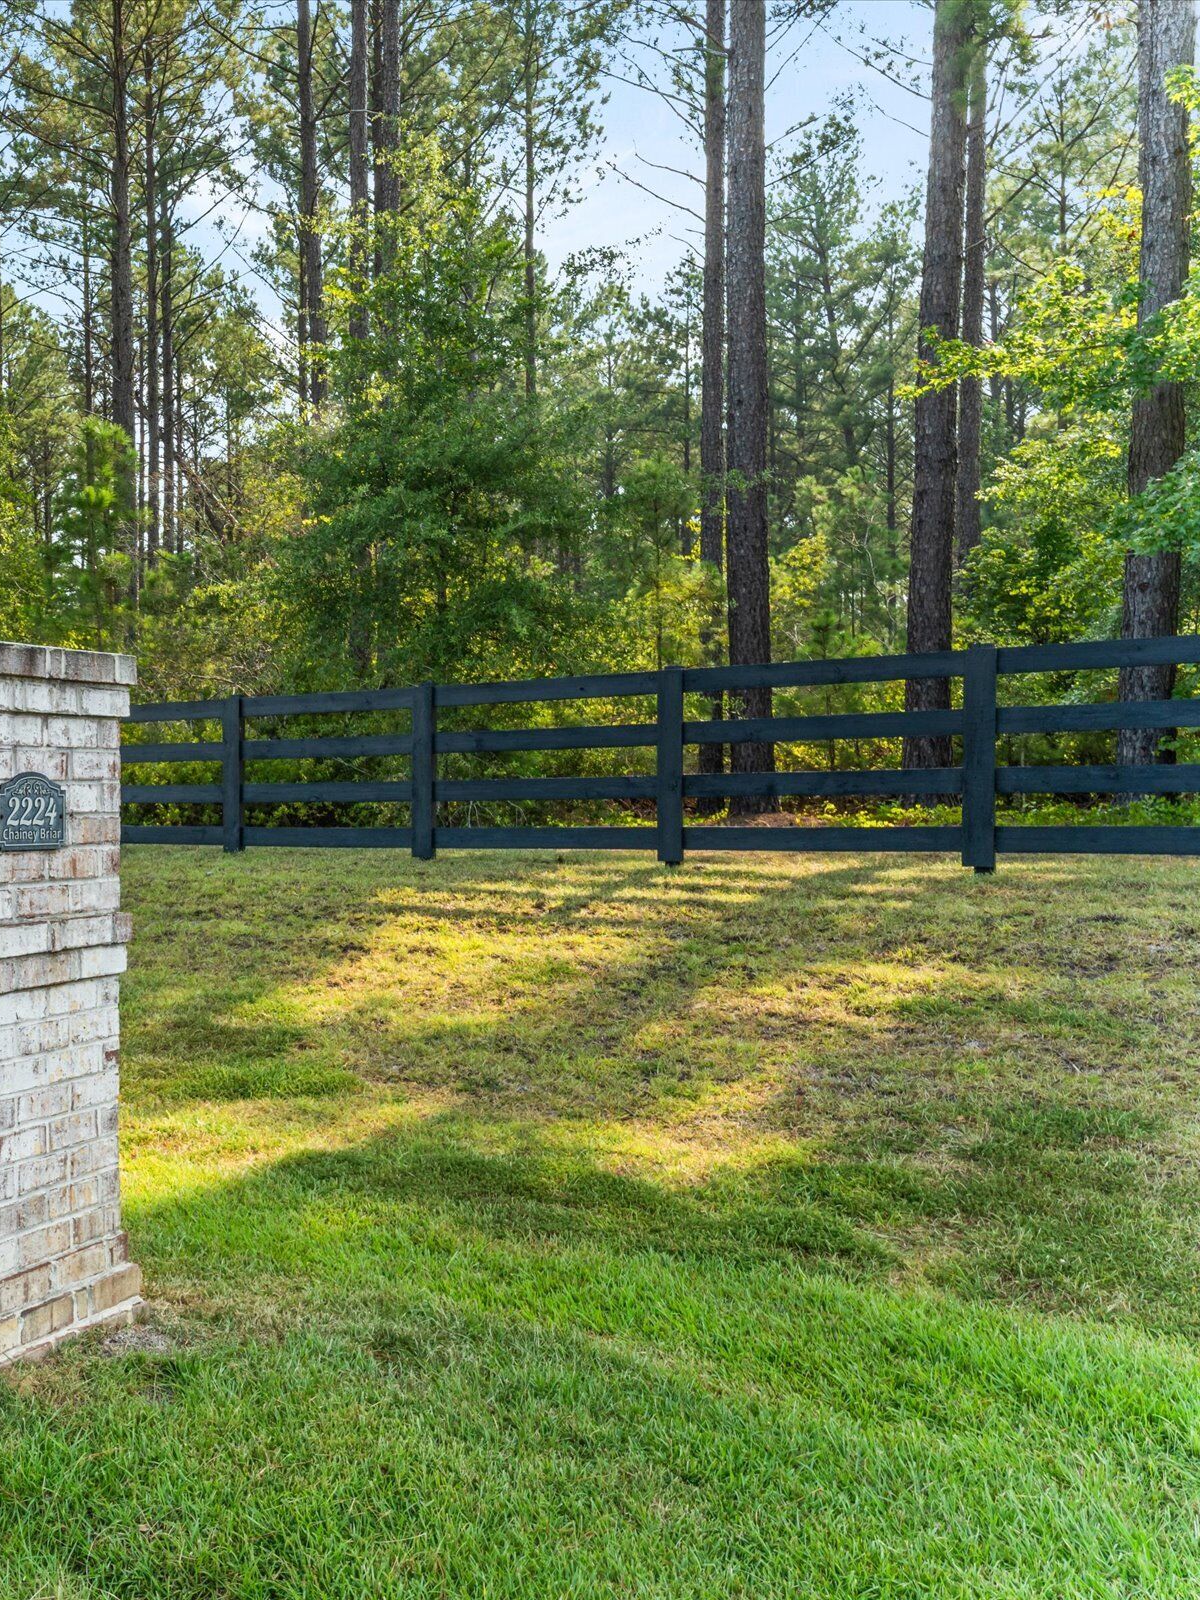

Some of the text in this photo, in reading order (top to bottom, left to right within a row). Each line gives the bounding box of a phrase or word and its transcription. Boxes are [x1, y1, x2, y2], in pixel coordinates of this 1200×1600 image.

[6, 796, 57, 826] 2224
[3, 827, 61, 843] Chainey Briar
